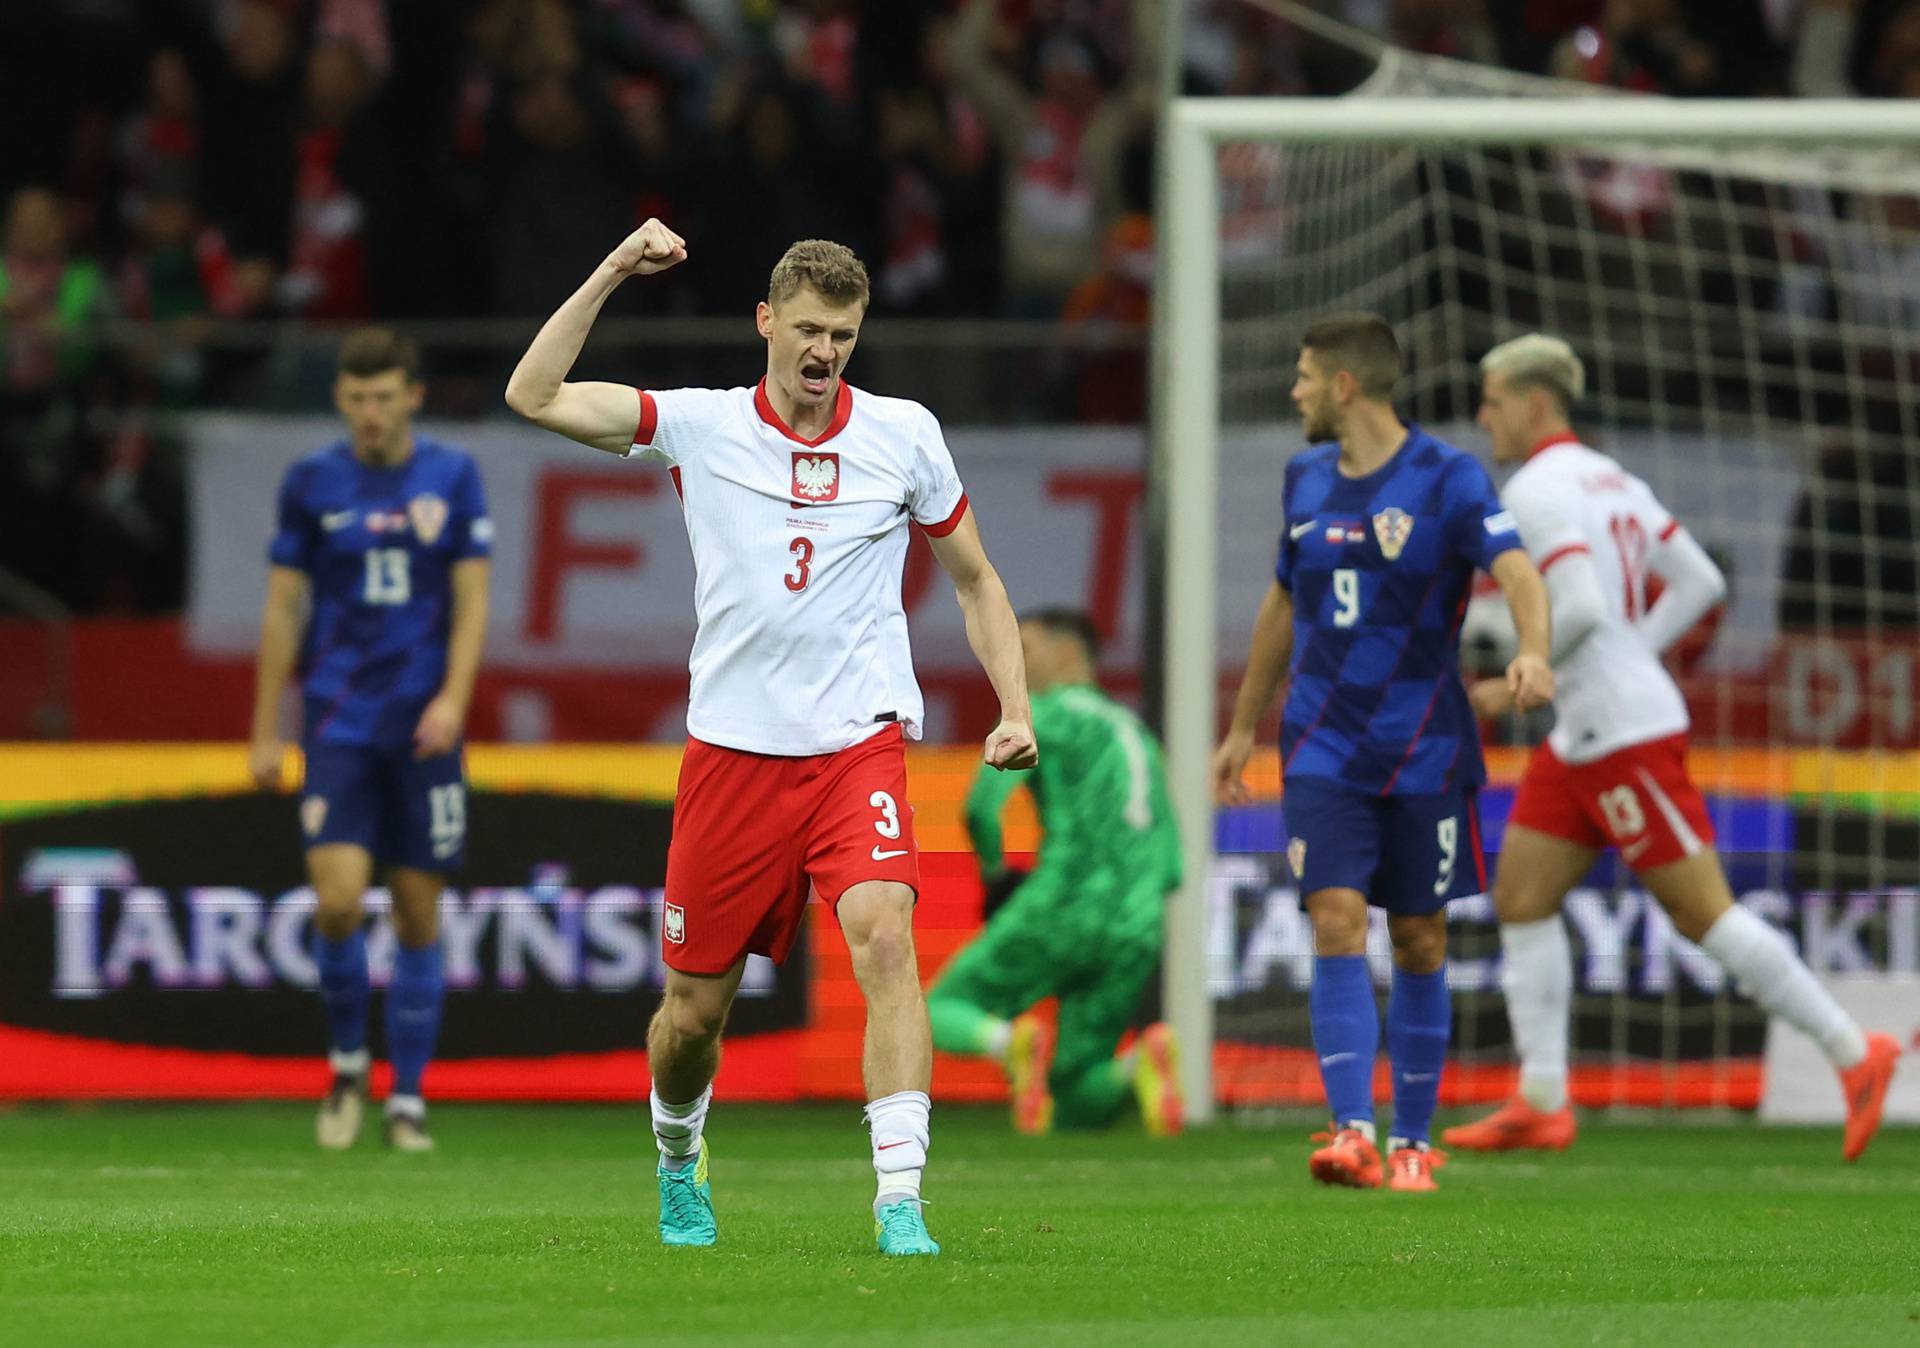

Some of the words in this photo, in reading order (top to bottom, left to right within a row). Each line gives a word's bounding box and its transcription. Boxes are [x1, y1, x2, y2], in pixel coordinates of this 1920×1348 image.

[364, 547, 412, 605] 13
[784, 536, 816, 594] 3
[1332, 568, 1359, 628] 9
[428, 782, 466, 841] 13
[868, 789, 901, 841] 3
[1436, 816, 1458, 874] 9
[19, 846, 777, 998] TARCYŃS
